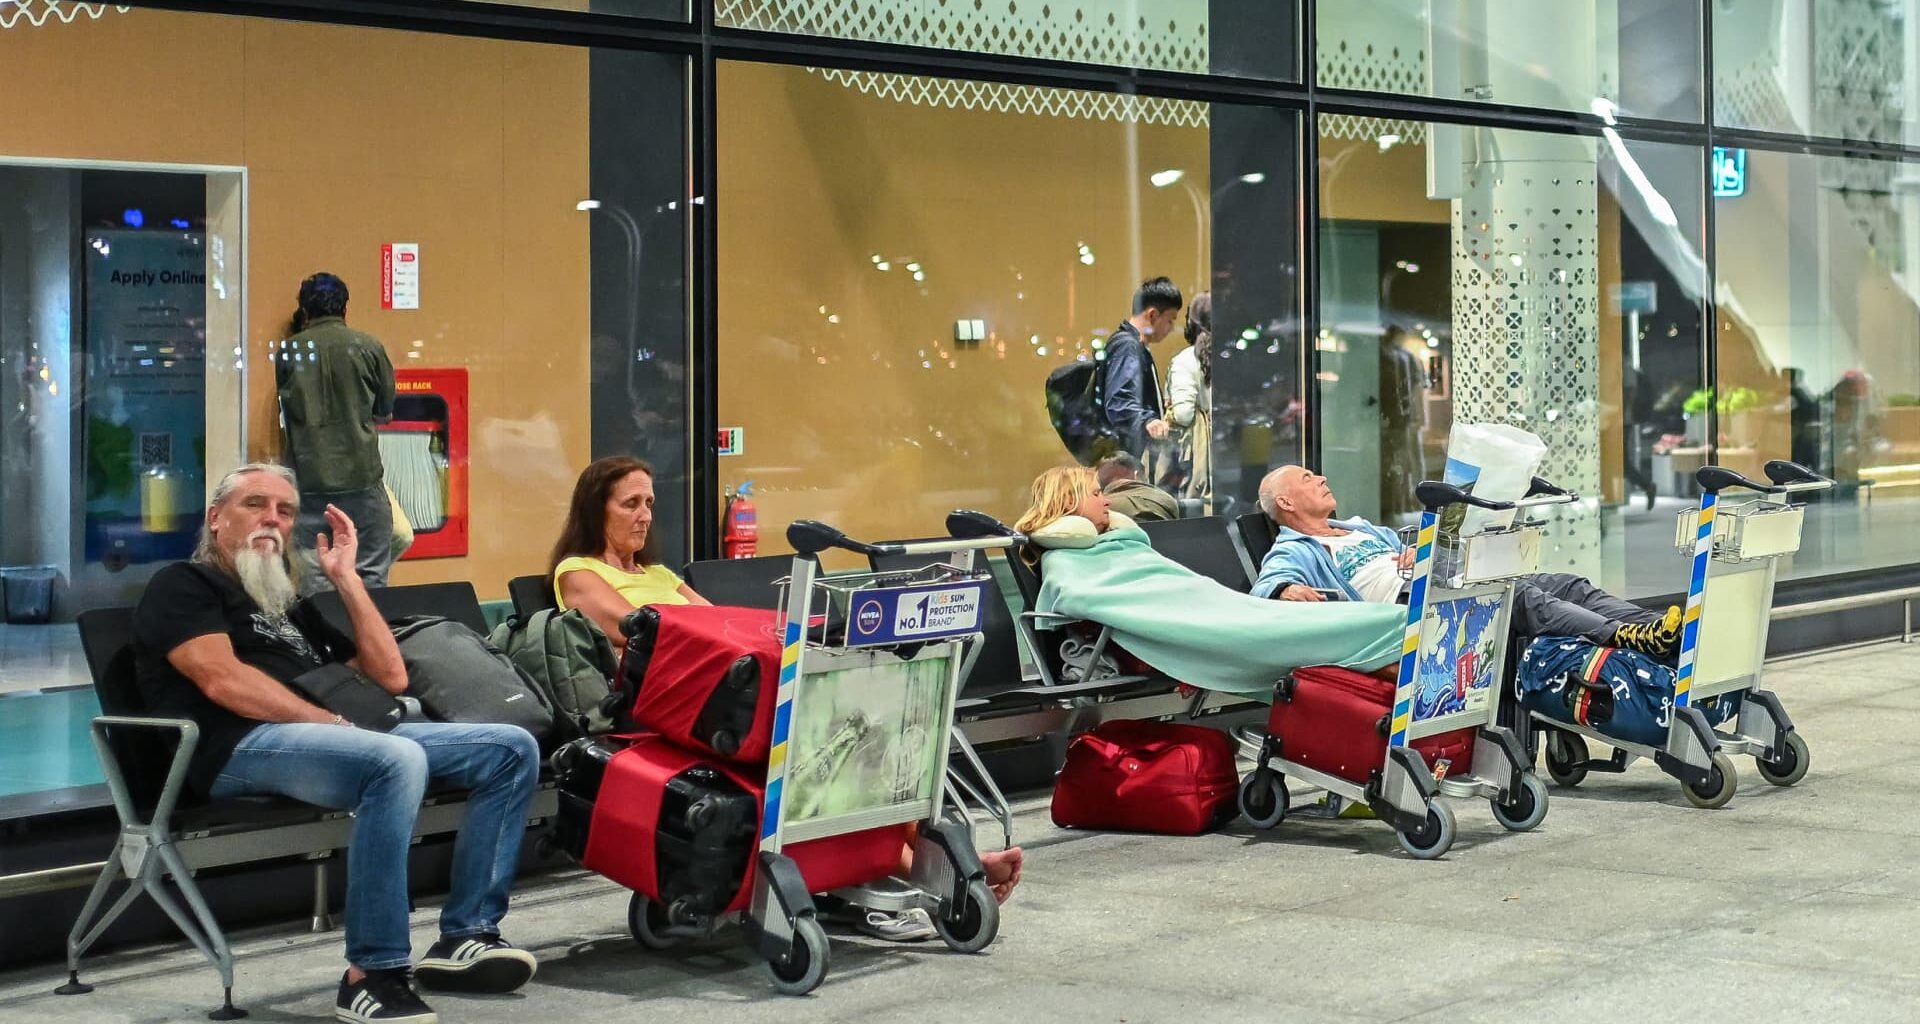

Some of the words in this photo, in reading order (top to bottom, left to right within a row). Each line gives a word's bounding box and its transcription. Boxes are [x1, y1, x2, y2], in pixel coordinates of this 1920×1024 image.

[110, 269, 155, 286] Apply
[395, 381, 411, 390] OSE
[412, 381, 432, 390] RACK
[950, 594, 965, 602] SUN
[929, 603, 975, 616] PROTECTION
[861, 611, 880, 619] NIVEA
